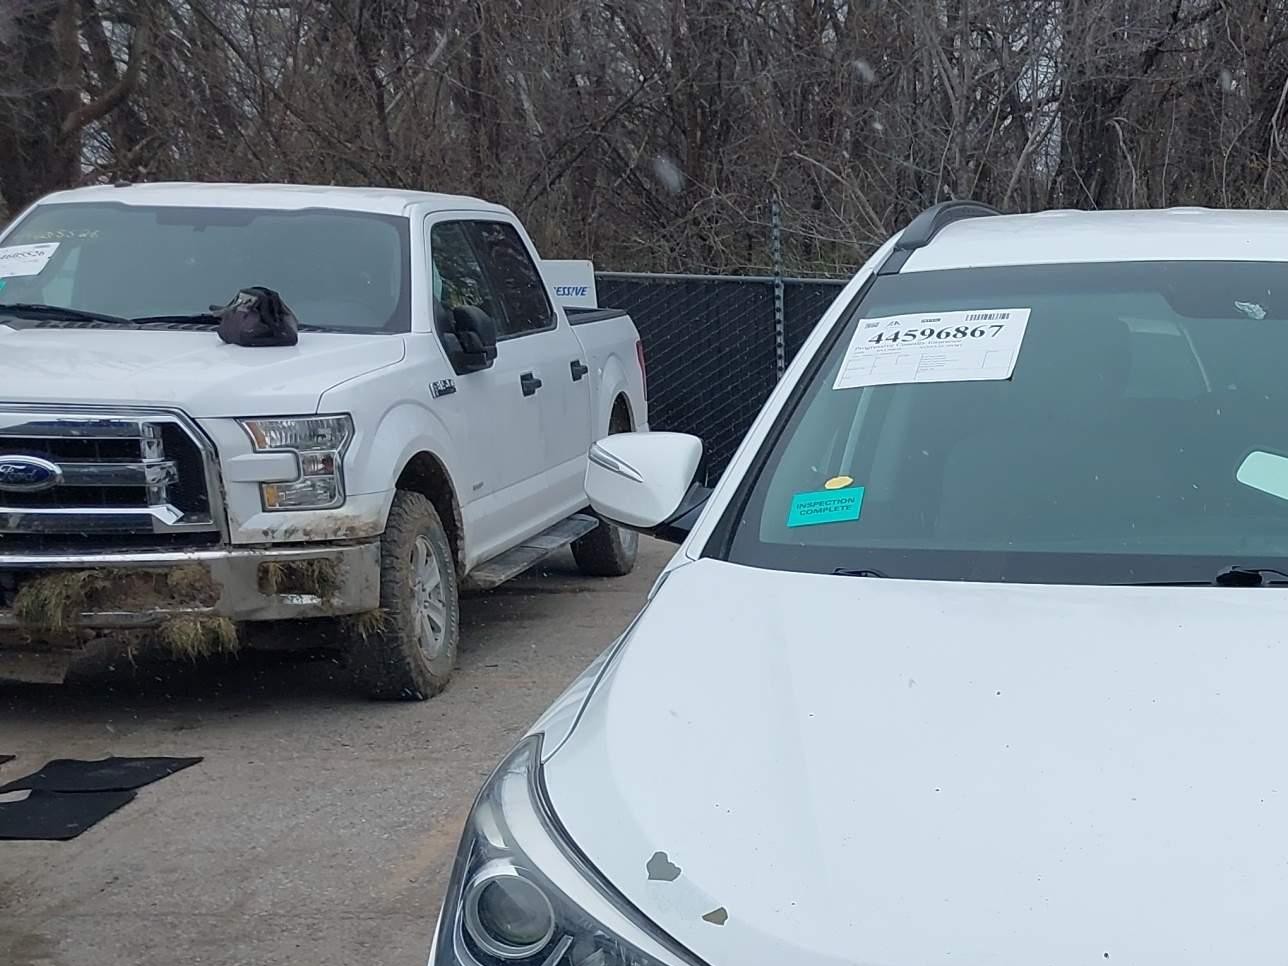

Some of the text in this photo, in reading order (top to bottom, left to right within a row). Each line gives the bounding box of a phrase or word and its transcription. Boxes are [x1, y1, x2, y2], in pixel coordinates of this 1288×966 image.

[553, 286, 588, 297] ESSIVE
[868, 324, 1005, 345] 44596867
[796, 496, 856, 510] INSPECTION
[800, 505, 853, 516] COMPLETE
